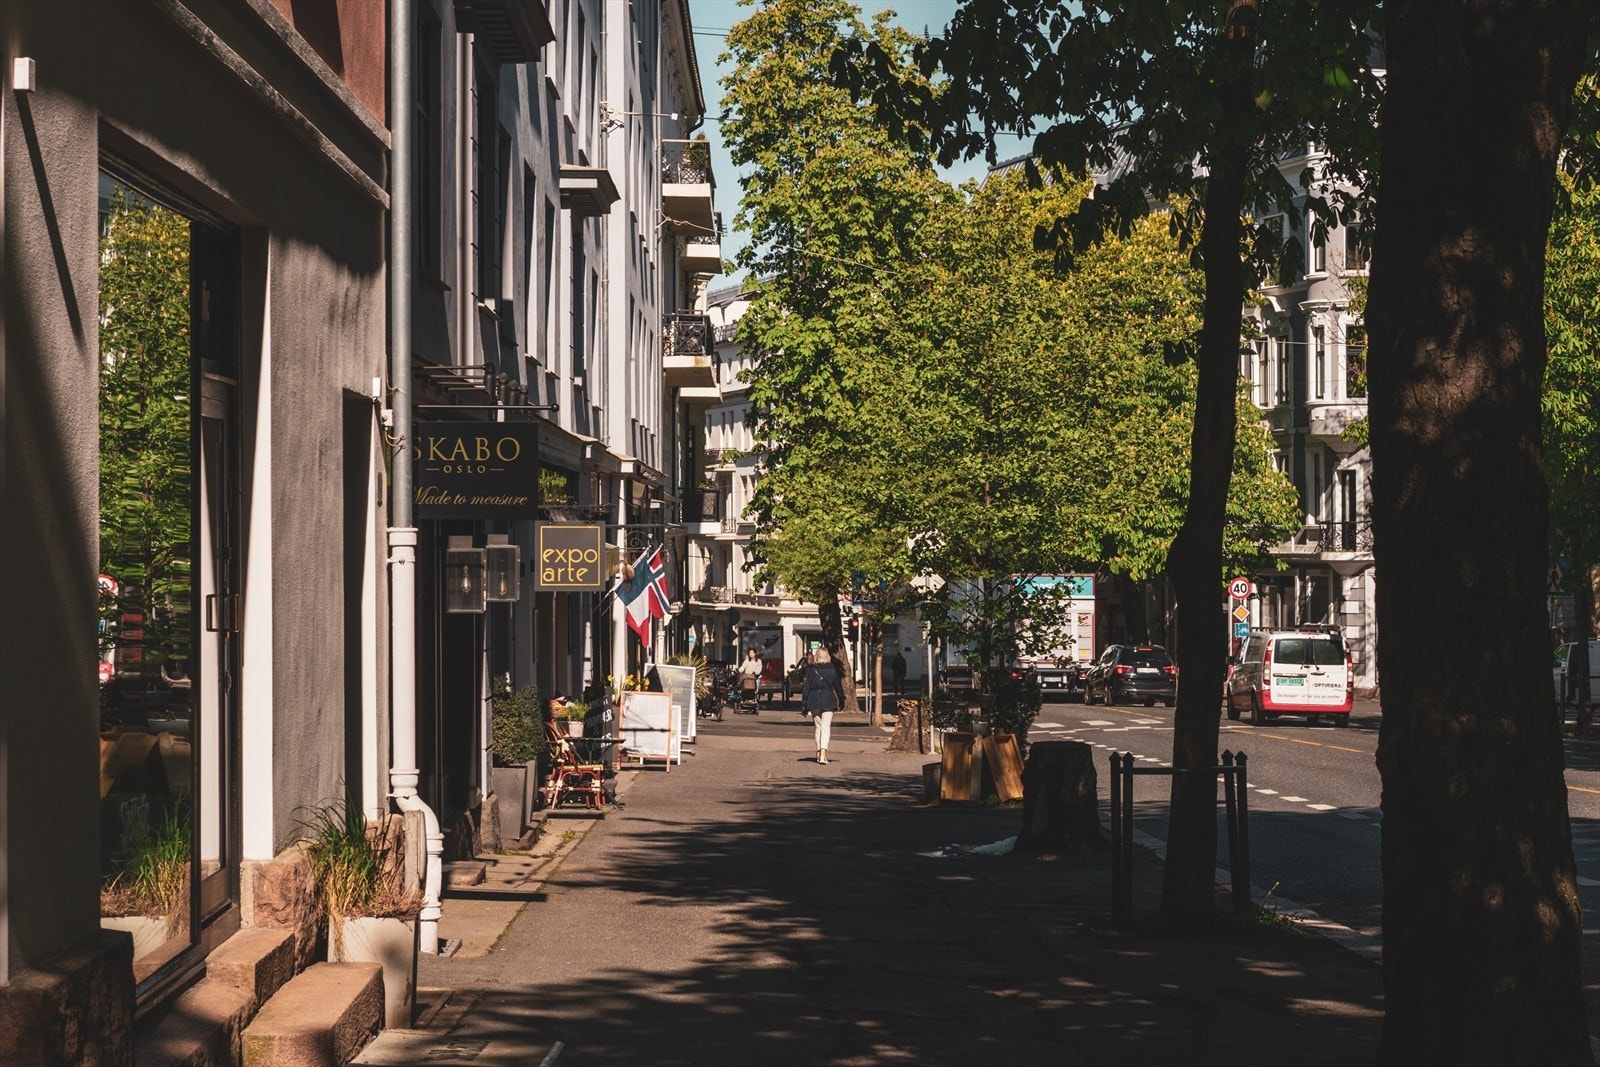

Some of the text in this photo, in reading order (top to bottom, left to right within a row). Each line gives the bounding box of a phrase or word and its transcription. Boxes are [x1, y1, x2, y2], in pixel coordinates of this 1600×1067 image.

[443, 464, 486, 474] OSLO
[453, 493, 467, 505] to
[470, 493, 529, 505] measure
[543, 548, 598, 570] expo
[543, 567, 589, 581] arte
[1234, 583, 1247, 594] 40
